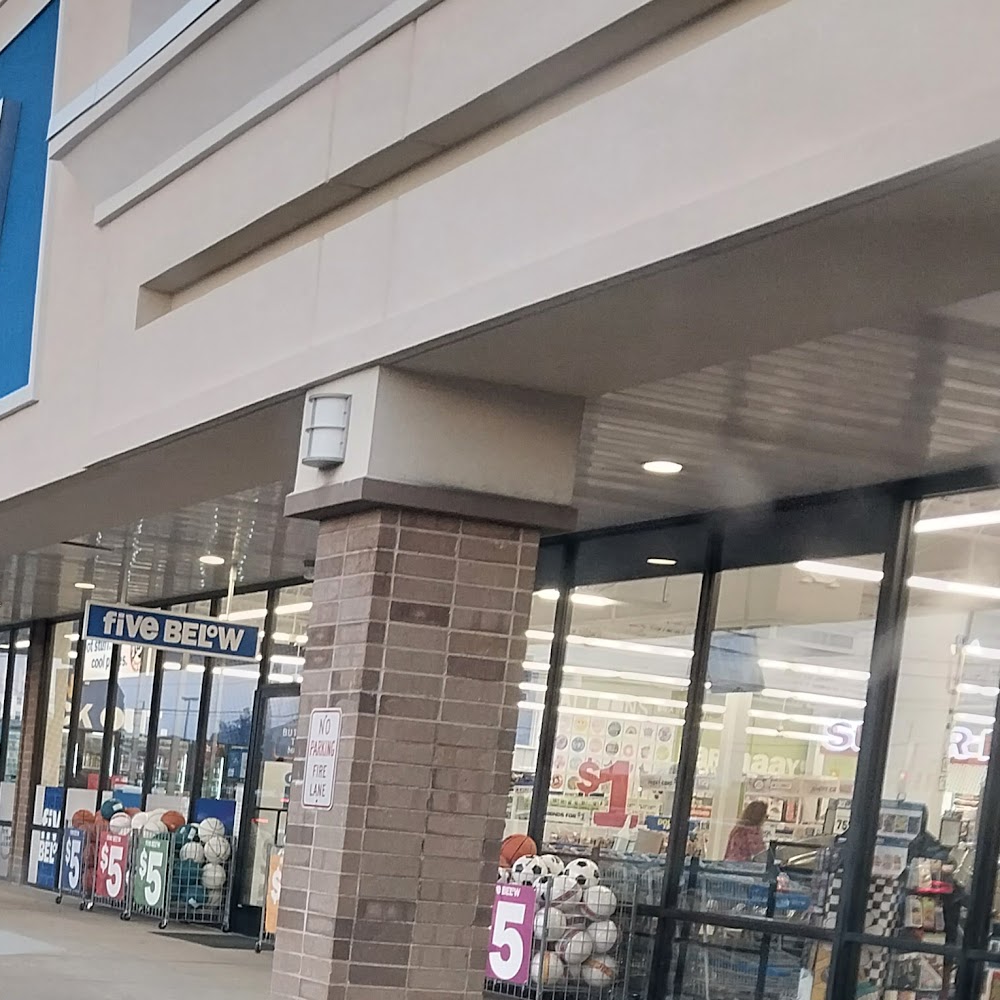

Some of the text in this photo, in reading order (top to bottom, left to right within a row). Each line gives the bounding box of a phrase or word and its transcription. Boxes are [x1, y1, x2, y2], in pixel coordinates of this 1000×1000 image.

[163, 619, 245, 652] BELOW
[318, 717, 332, 736] NO
[309, 740, 335, 757] PARKING
[312, 764, 327, 779] FIRE
[309, 783, 326, 798] LANE
[65, 836, 82, 890] $5
[100, 841, 124, 898] $5
[138, 847, 164, 907] $5
[488, 900, 527, 981] 5
